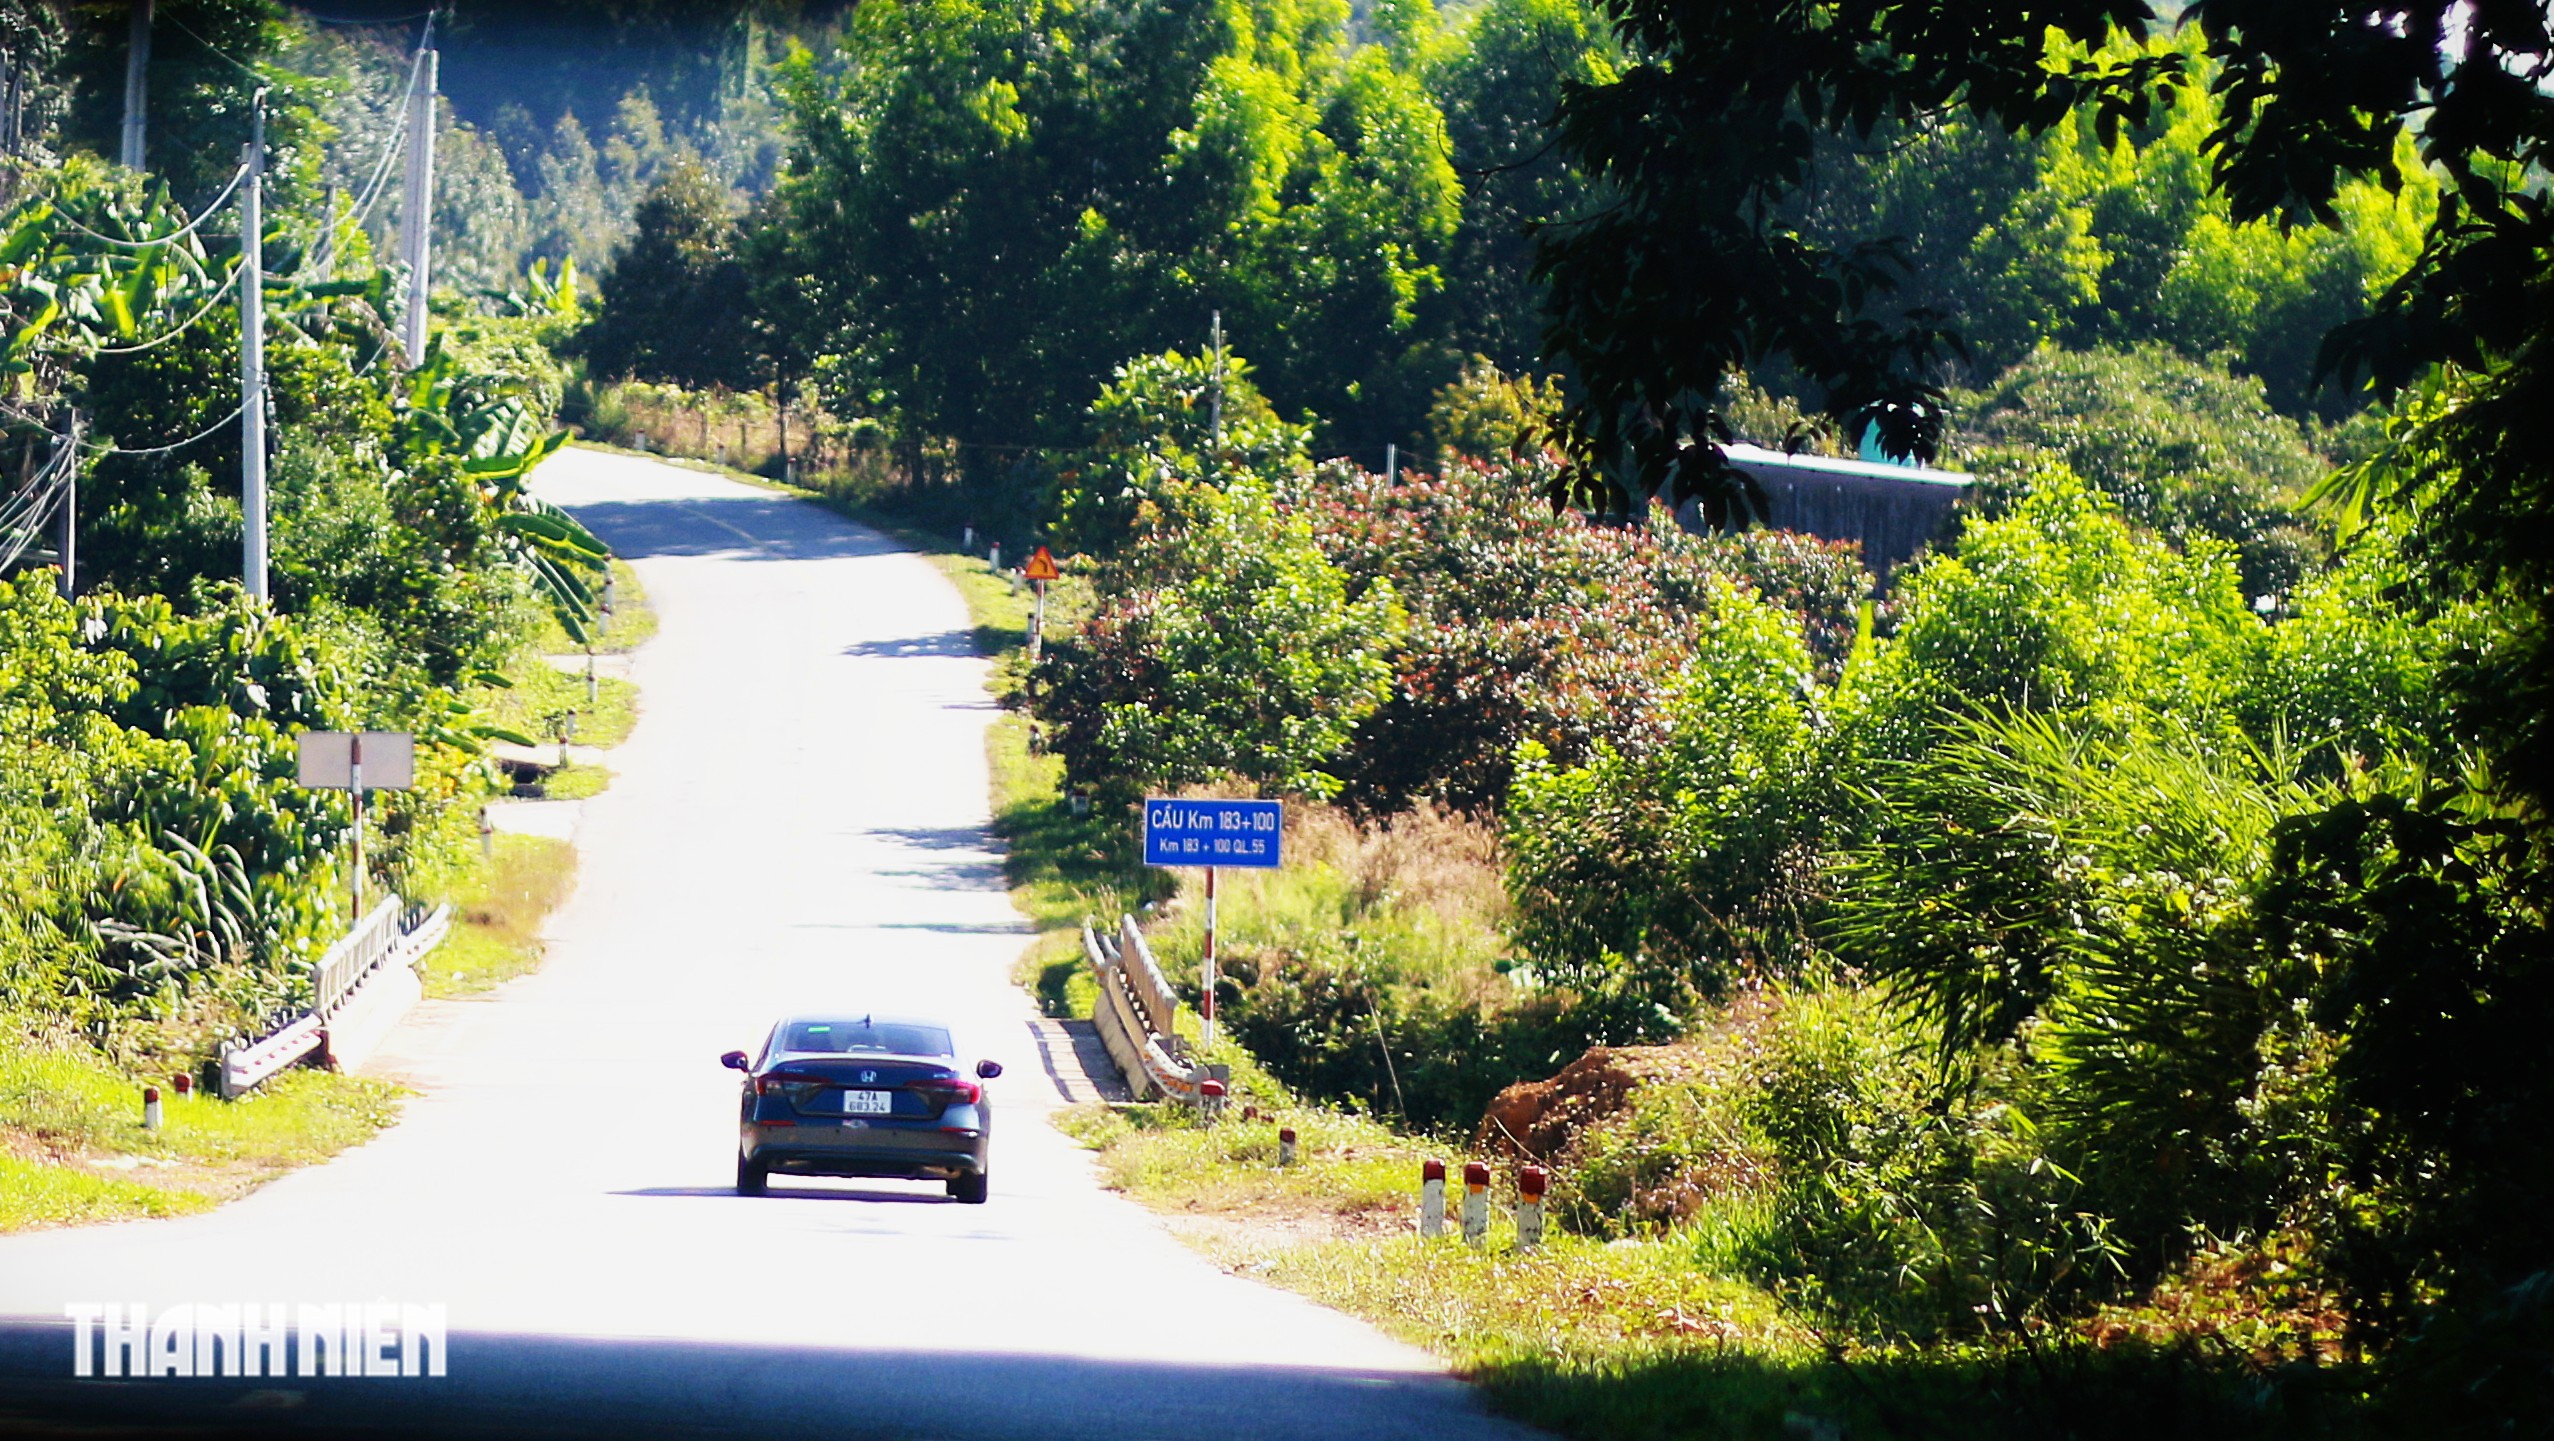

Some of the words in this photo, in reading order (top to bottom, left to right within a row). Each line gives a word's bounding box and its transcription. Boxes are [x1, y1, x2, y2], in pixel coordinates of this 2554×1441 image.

[1188, 809, 1213, 829] Km
[1219, 811, 1274, 831] 183+100
[1160, 838, 1179, 852] Km
[1183, 838, 1199, 853] 183
[1214, 838, 1231, 853] 100
[858, 1091, 878, 1101] 47A
